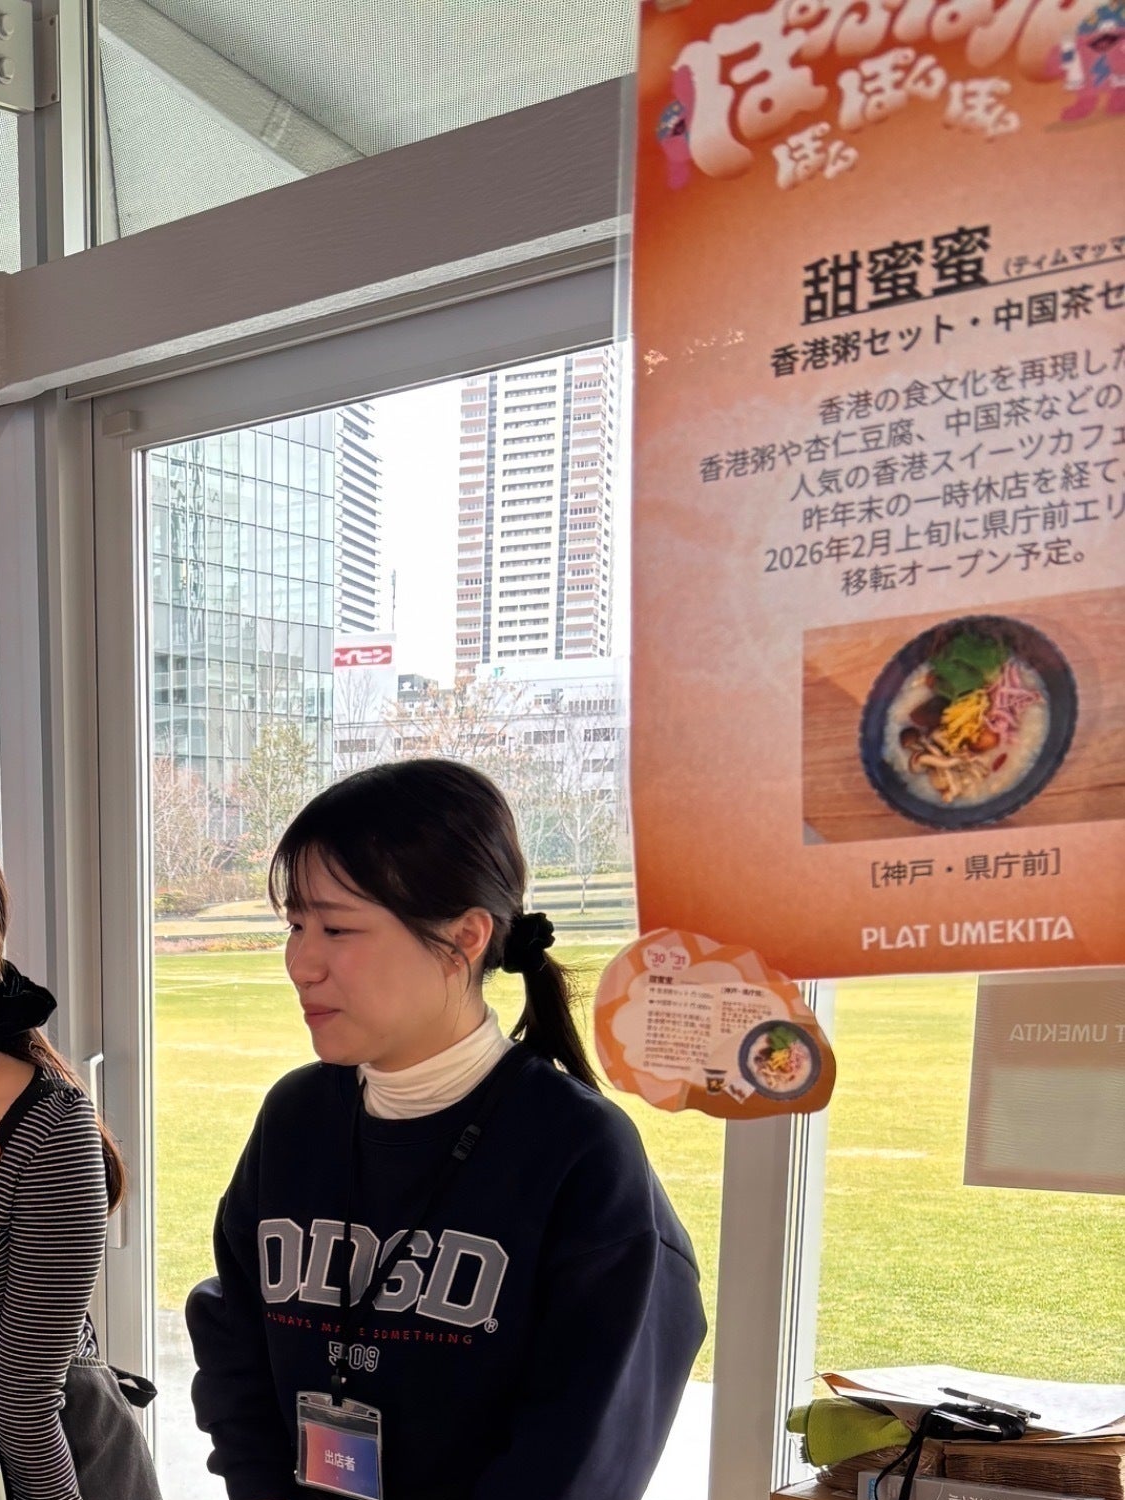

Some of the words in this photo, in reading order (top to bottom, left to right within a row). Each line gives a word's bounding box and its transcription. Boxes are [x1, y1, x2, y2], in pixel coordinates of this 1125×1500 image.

[802, 224, 992, 324] 甜蜜蜜
[699, 382, 1122, 484] 香港粥や杏仁豆腐、中国茶などの
[841, 538, 1086, 597] 移転オープン予定。
[870, 847, 1061, 889] [神戸・県庁前]
[861, 924, 931, 950] PLAT
[939, 916, 1074, 946] UMEKITA
[373, 1328, 474, 1345] SOMETHING
[324, 1449, 356, 1473] 出店者
